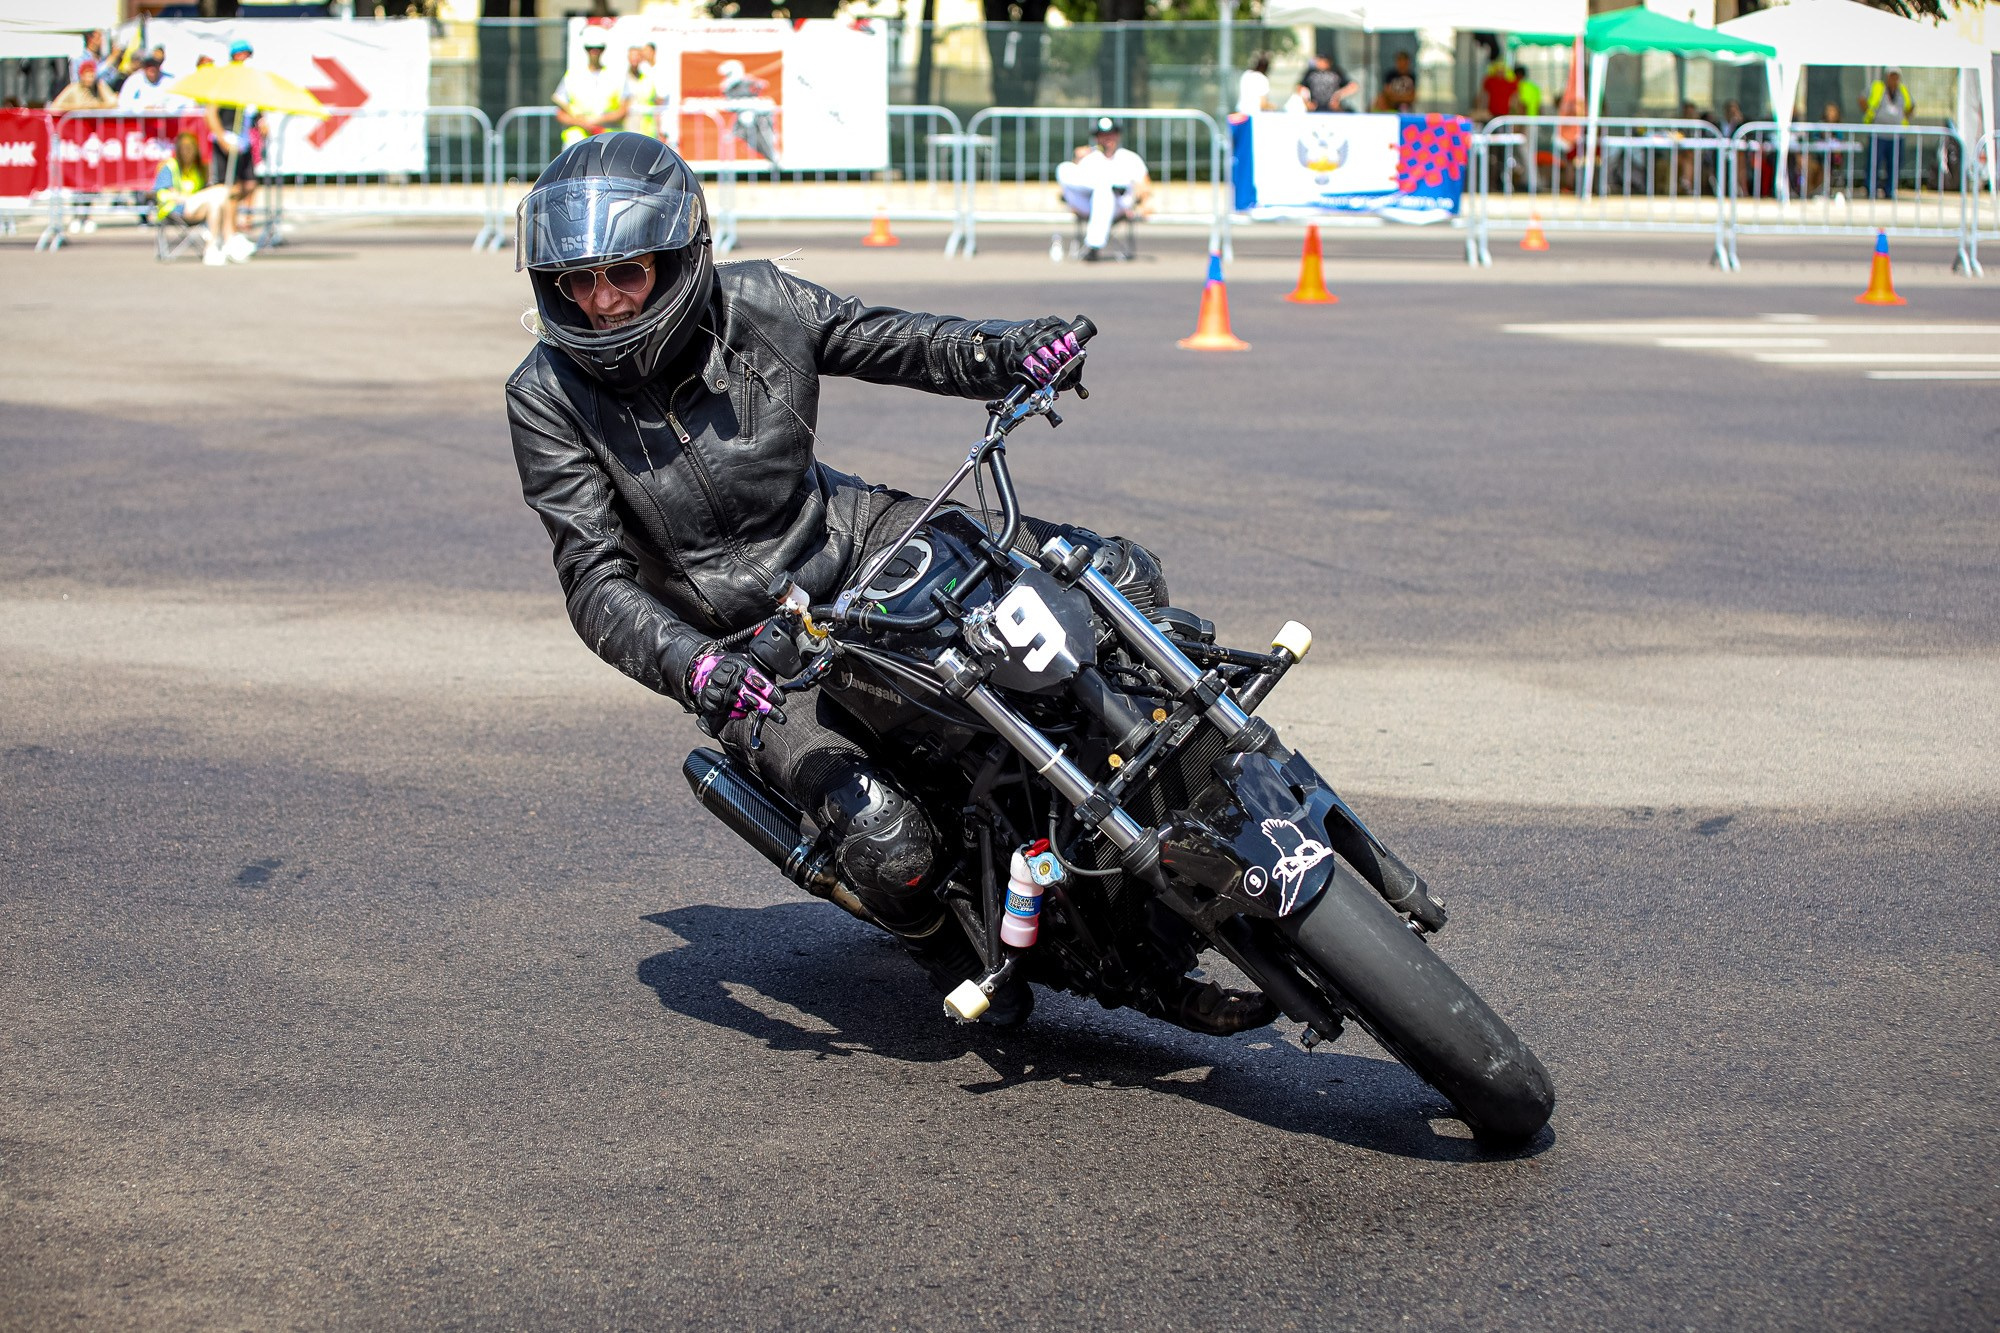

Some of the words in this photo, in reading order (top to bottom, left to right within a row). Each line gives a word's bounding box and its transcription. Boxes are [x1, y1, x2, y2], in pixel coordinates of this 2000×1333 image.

[996, 585, 1066, 673] 9
[841, 671, 902, 704] Kawasaki
[1249, 874, 1262, 889] 9
